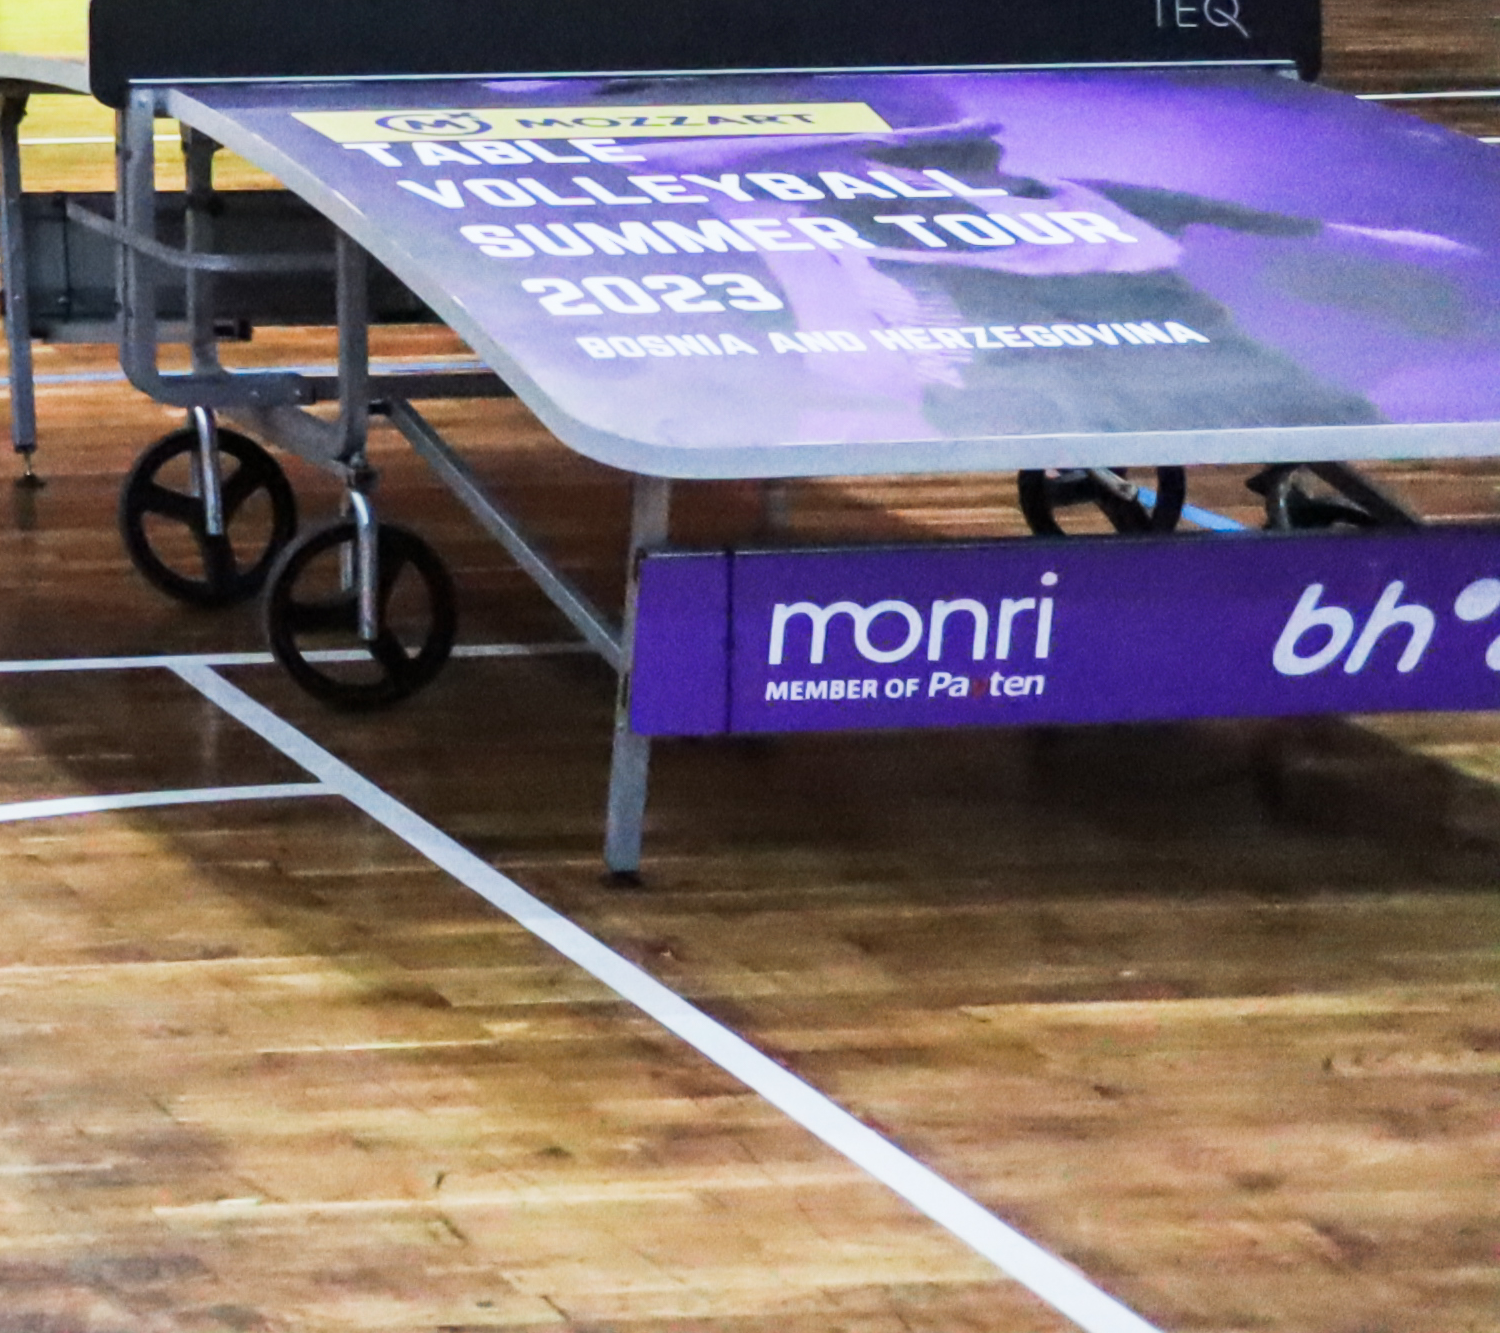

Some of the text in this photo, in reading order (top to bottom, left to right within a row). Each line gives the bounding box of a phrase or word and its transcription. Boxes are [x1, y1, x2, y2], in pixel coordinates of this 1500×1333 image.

[513, 111, 820, 132] MOZZART
[342, 138, 647, 169] TABLE
[396, 168, 1009, 210] VOLLEYBALL
[458, 209, 1139, 259] SUMMER TOUR
[521, 271, 785, 317] 2023
[575, 320, 1211, 360] BOSNIA AND HERZEGOVINA
[768, 572, 1059, 665] monri
[765, 669, 1047, 702] MEMBER OF Paten
